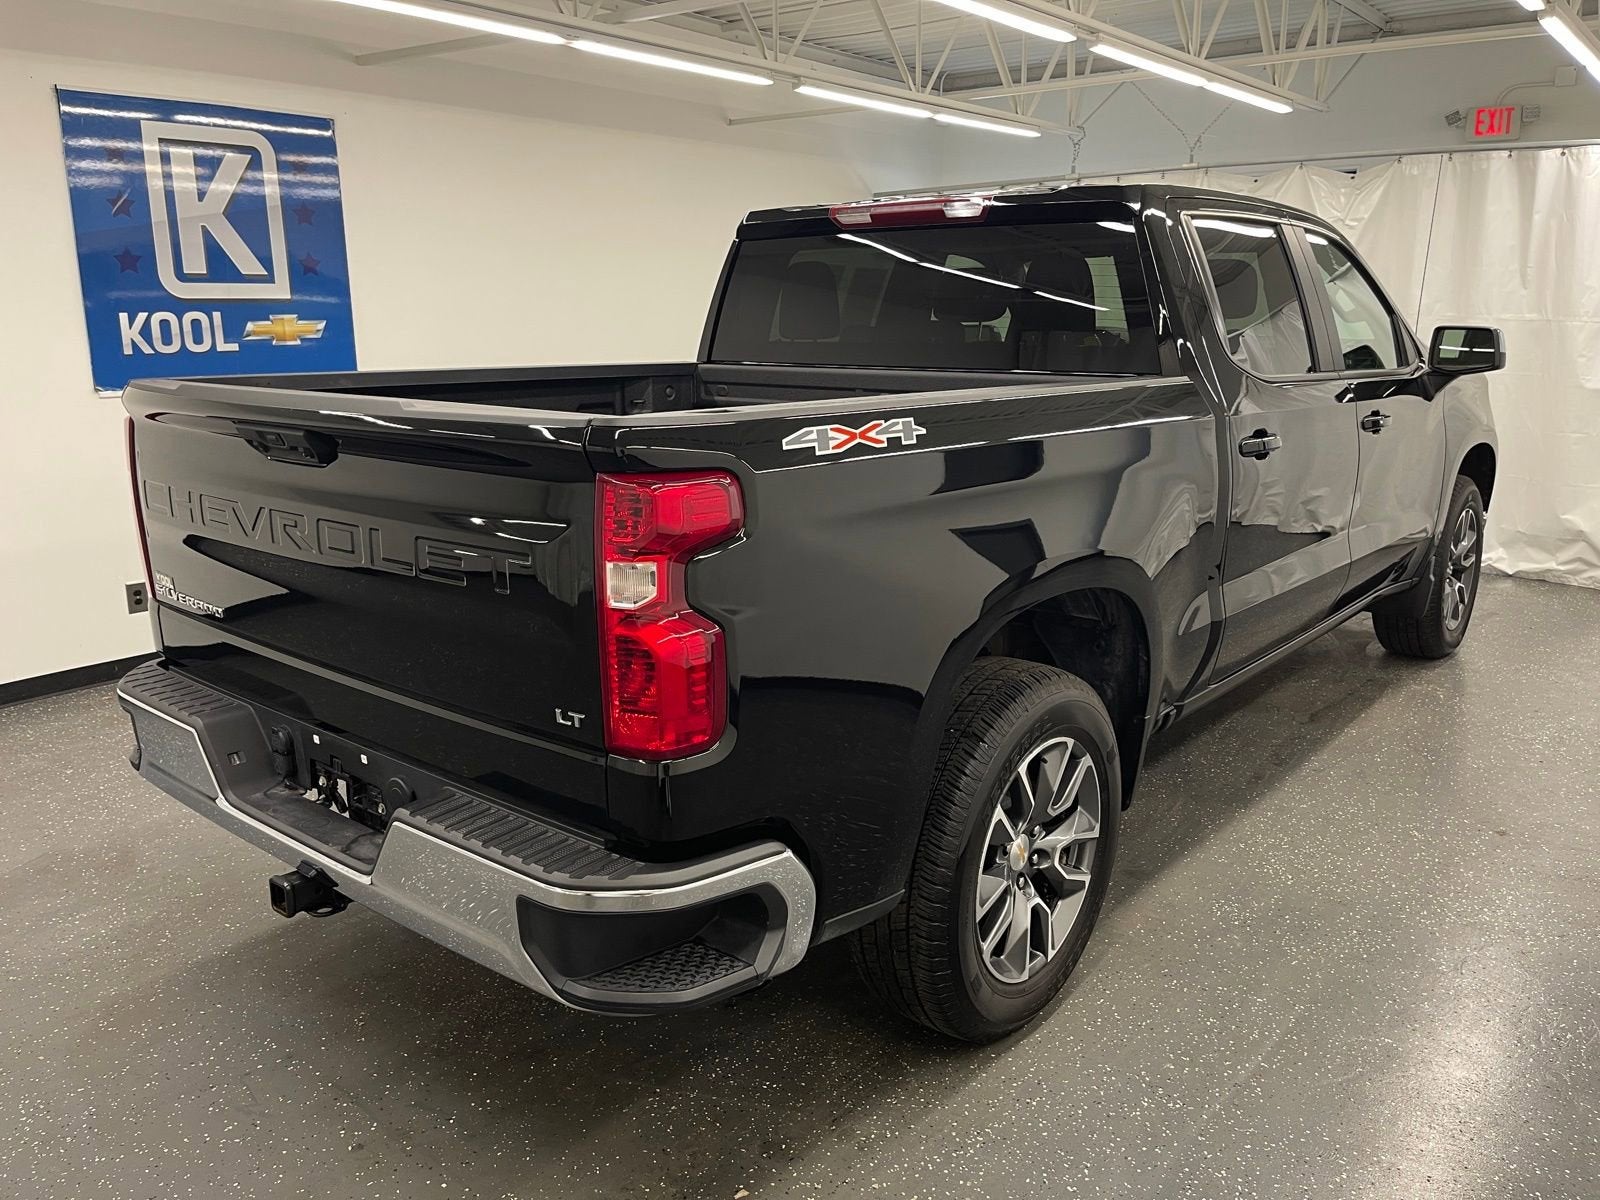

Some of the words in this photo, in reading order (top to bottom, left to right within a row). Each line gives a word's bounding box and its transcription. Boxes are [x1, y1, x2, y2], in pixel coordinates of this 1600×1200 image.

[1474, 107, 1515, 136] EXIT
[118, 311, 240, 355] KOOL
[144, 479, 532, 595] CHEVROLET
[155, 583, 224, 618] SILVERADO
[554, 707, 586, 728] LT
